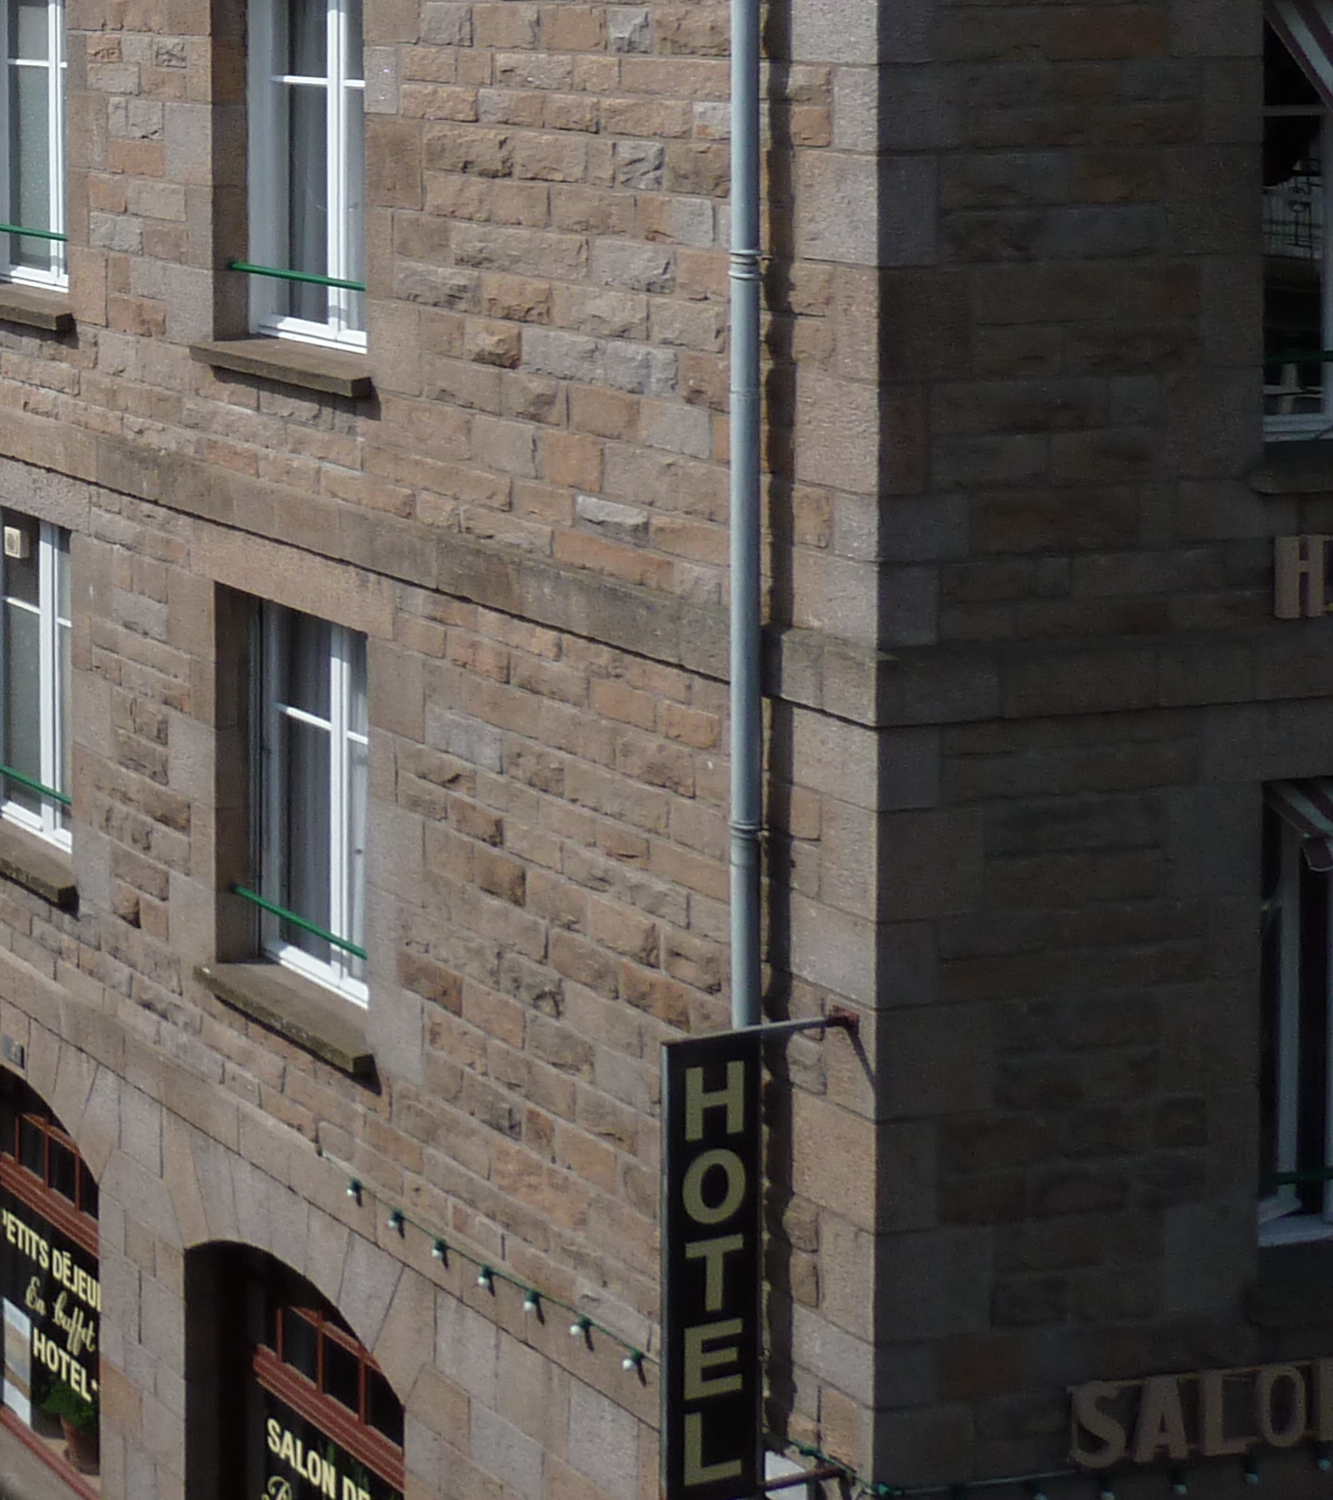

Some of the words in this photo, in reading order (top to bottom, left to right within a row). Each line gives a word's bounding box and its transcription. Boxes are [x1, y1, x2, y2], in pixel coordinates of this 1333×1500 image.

[682, 1060, 747, 1487] HOTEL
[33, 1326, 92, 1403] HOTEL
[267, 1417, 337, 1499] SALON
